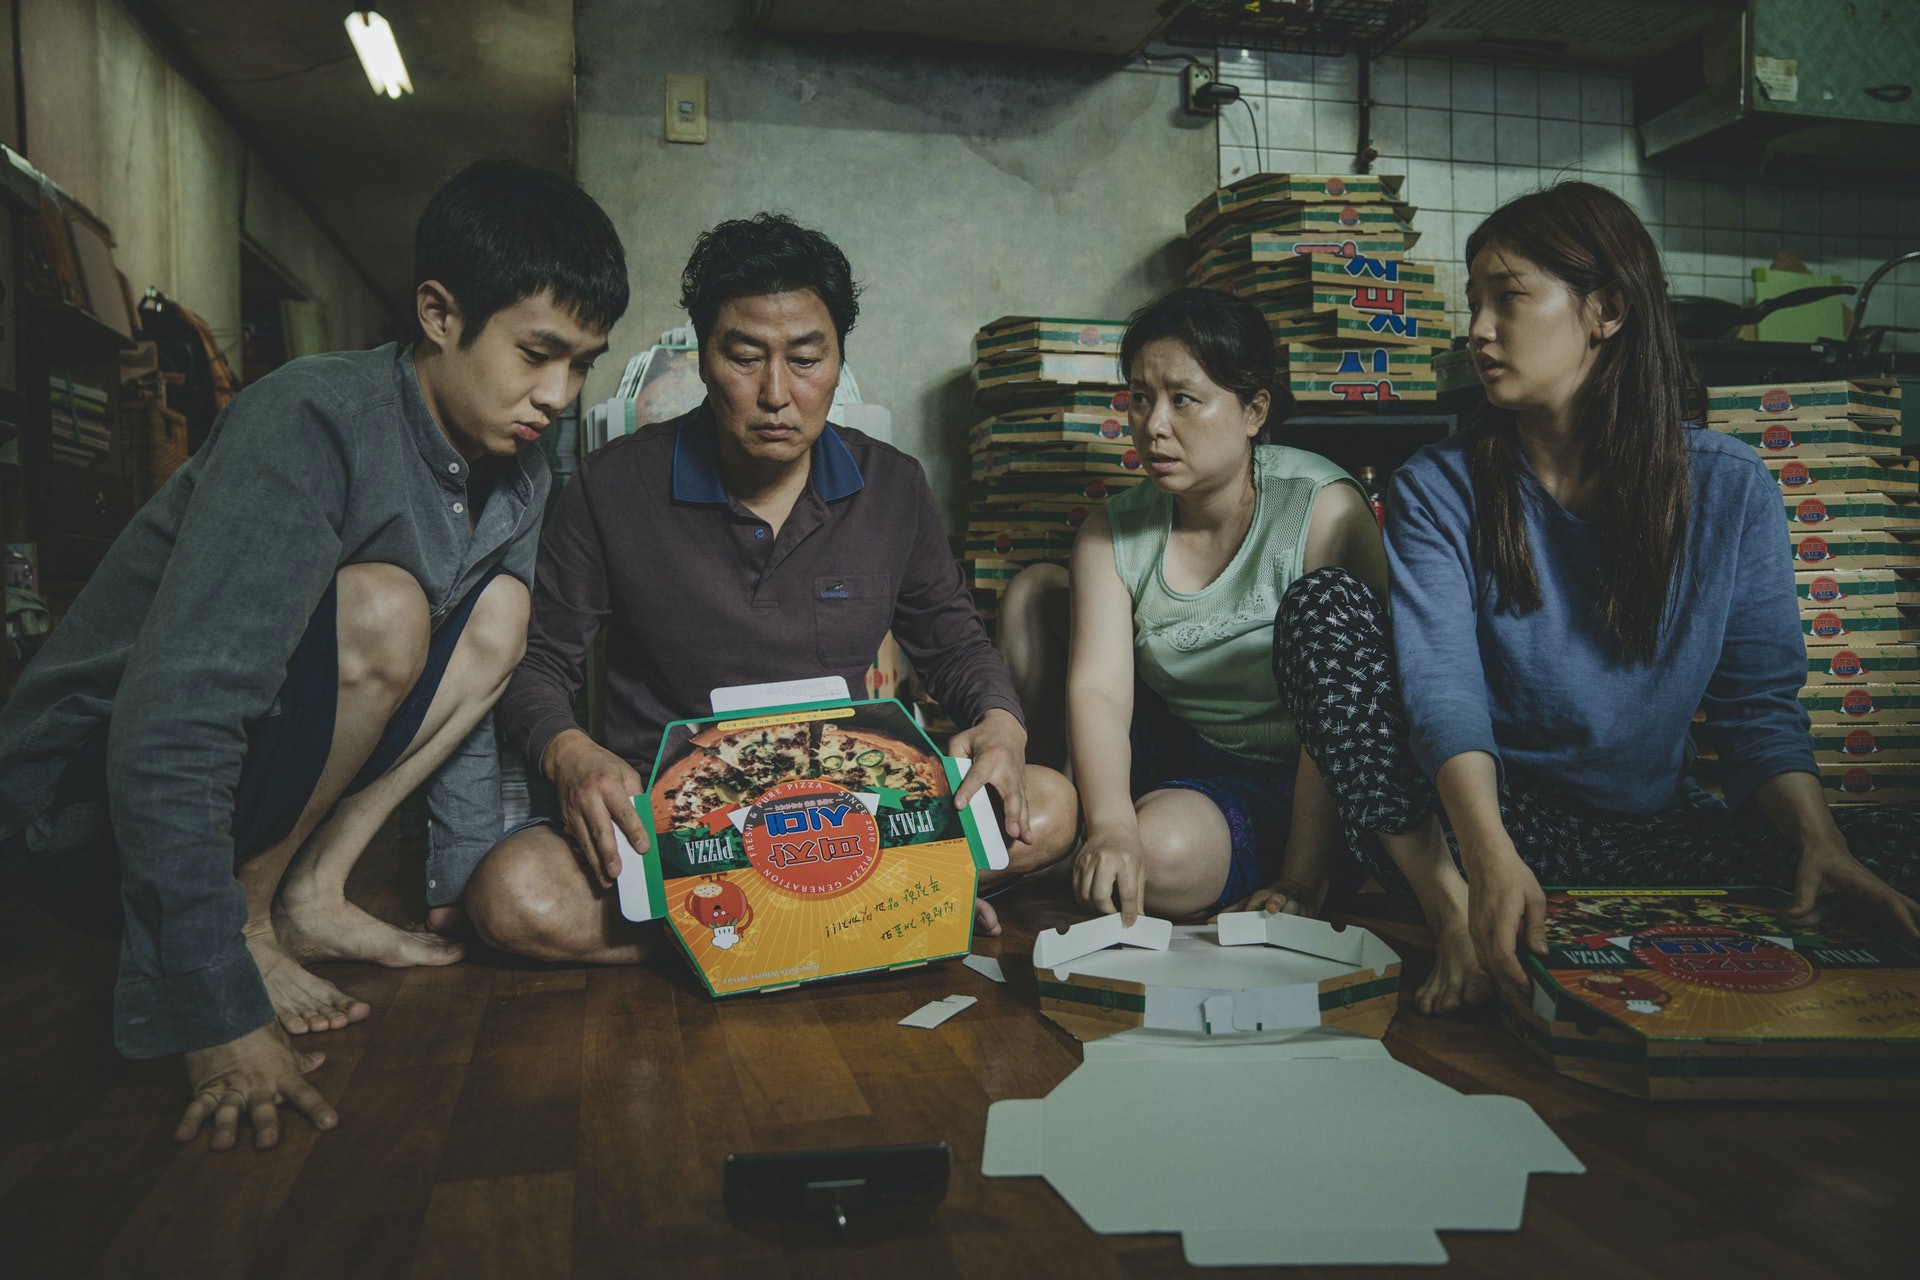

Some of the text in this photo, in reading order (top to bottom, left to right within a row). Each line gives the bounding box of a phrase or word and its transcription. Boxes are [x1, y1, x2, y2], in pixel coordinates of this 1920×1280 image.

[744, 823, 758, 858] FRESH
[757, 787, 783, 809] PURE
[786, 781, 823, 791] PIZZA
[764, 804, 852, 837] 시대
[838, 790, 876, 843] SINCE 2010
[889, 809, 936, 838] ITALY
[684, 836, 734, 865] PIZZA
[767, 835, 865, 869] 피자
[763, 855, 873, 893] PIZZA GENERATION
[903, 874, 941, 905] 푸짐한
[874, 897, 899, 912] 양과
[880, 918, 917, 941] 재료와
[1562, 950, 1627, 965] PIZZA
[1650, 940, 1760, 956] 시대
[1811, 948, 1881, 965] ITALY
